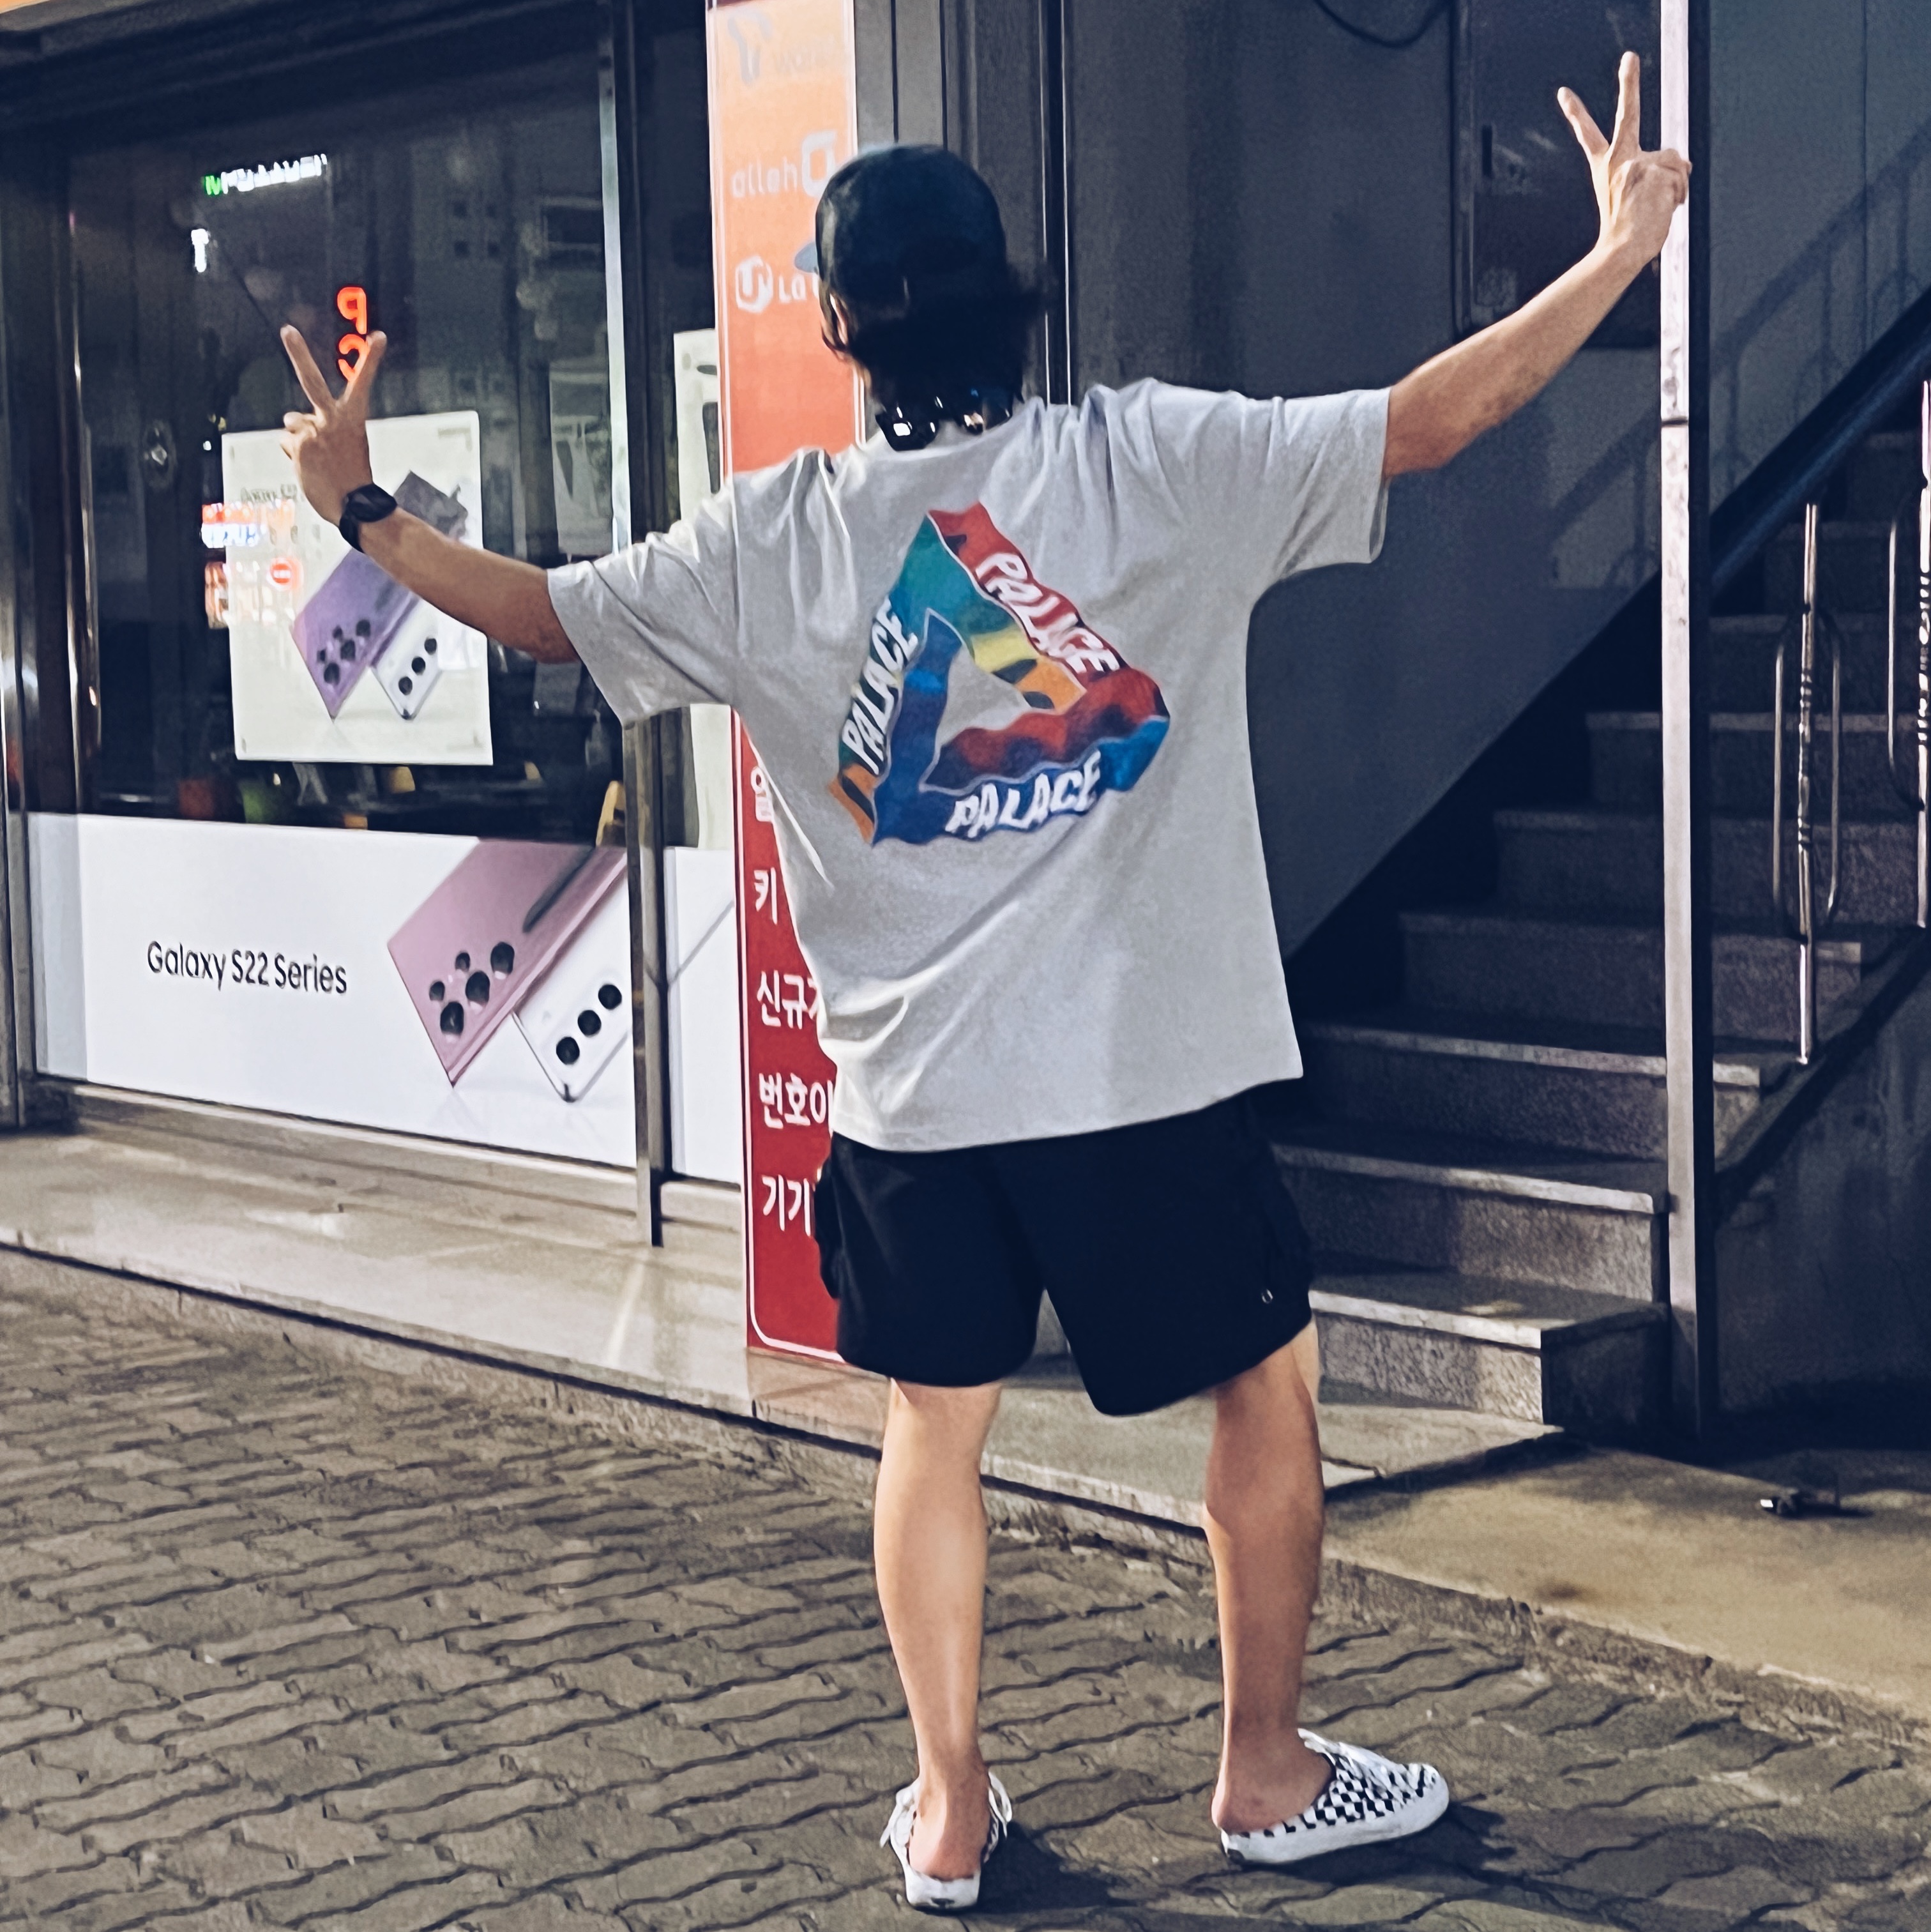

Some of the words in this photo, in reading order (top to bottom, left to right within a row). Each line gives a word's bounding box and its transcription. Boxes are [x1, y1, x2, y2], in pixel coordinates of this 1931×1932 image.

[975, 552, 1120, 674] PALACE
[842, 594, 918, 775] PALACE
[945, 750, 1101, 838] PALACE
[148, 941, 226, 991] Galaxy
[231, 948, 269, 986] S22
[274, 952, 347, 995] Series
